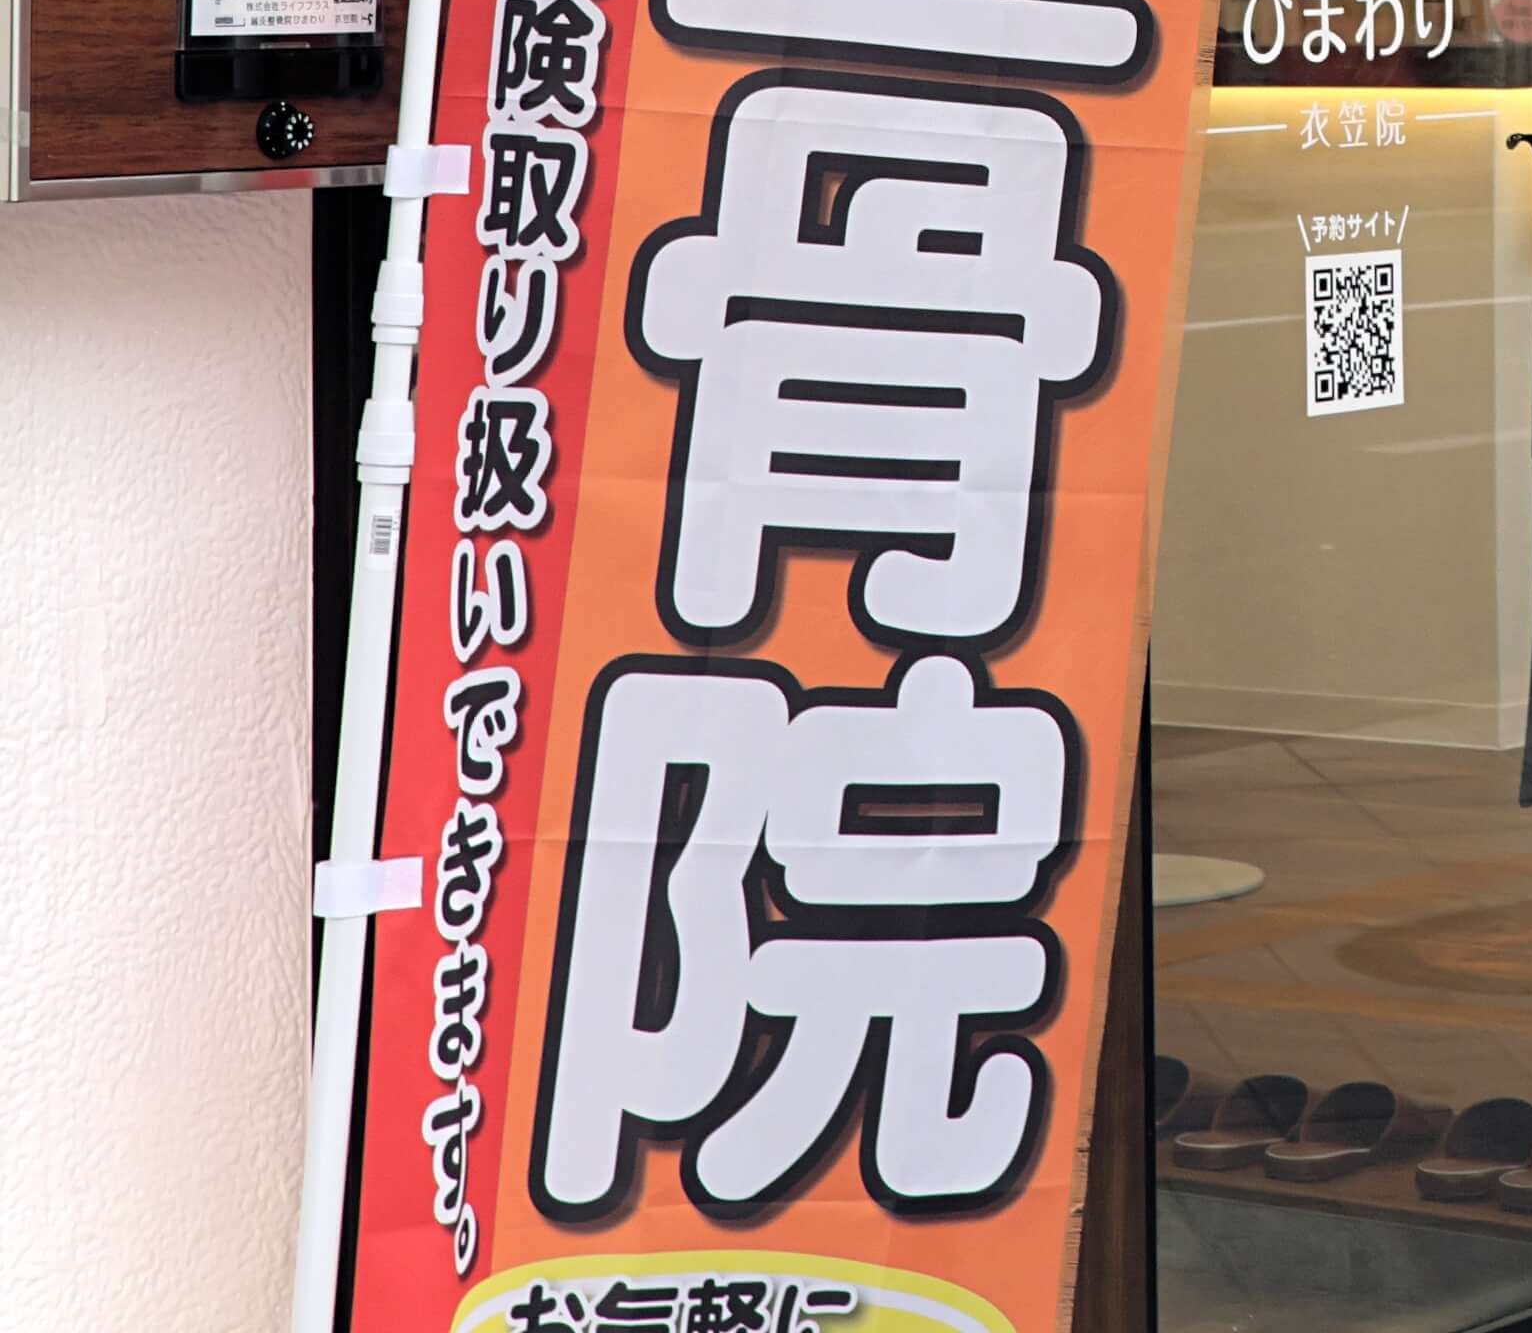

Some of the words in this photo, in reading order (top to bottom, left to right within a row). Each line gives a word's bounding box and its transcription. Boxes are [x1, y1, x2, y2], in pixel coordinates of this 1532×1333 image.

[1298, 99, 1407, 151] 衣笠院
[1310, 211, 1398, 244] 予約サイト
